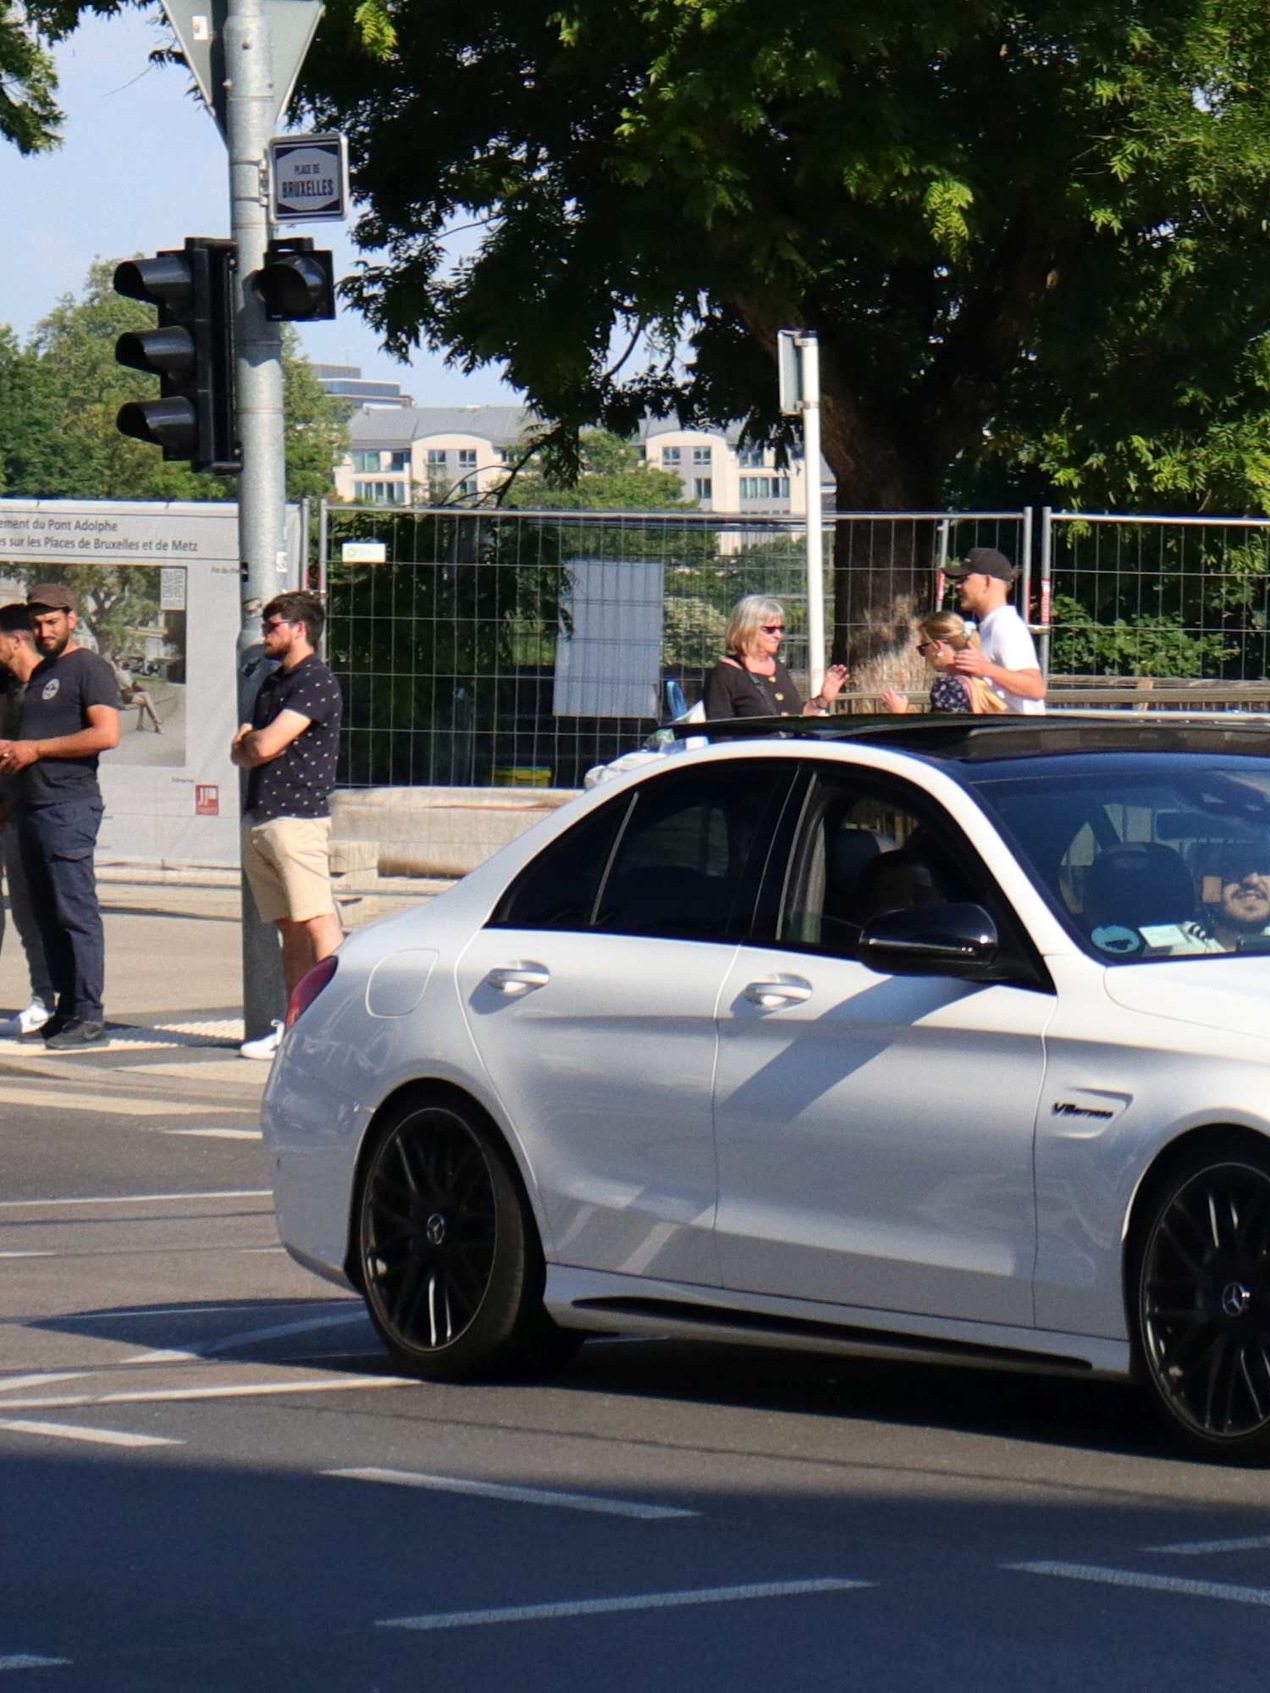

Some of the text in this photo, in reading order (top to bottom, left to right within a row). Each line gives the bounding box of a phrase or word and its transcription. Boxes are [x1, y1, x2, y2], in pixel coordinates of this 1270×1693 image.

[282, 179, 334, 198] BRUXELLES
[32, 518, 46, 530] du
[48, 519, 72, 530] Pont
[74, 519, 118, 533] Adolphe
[9, 538, 25, 548] sur
[27, 536, 42, 548] les
[44, 536, 76, 549] Places
[78, 538, 91, 549] de
[93, 538, 140, 550] Bruxelles
[142, 540, 153, 551] et
[155, 539, 169, 551] de
[171, 540, 198, 552] Metz
